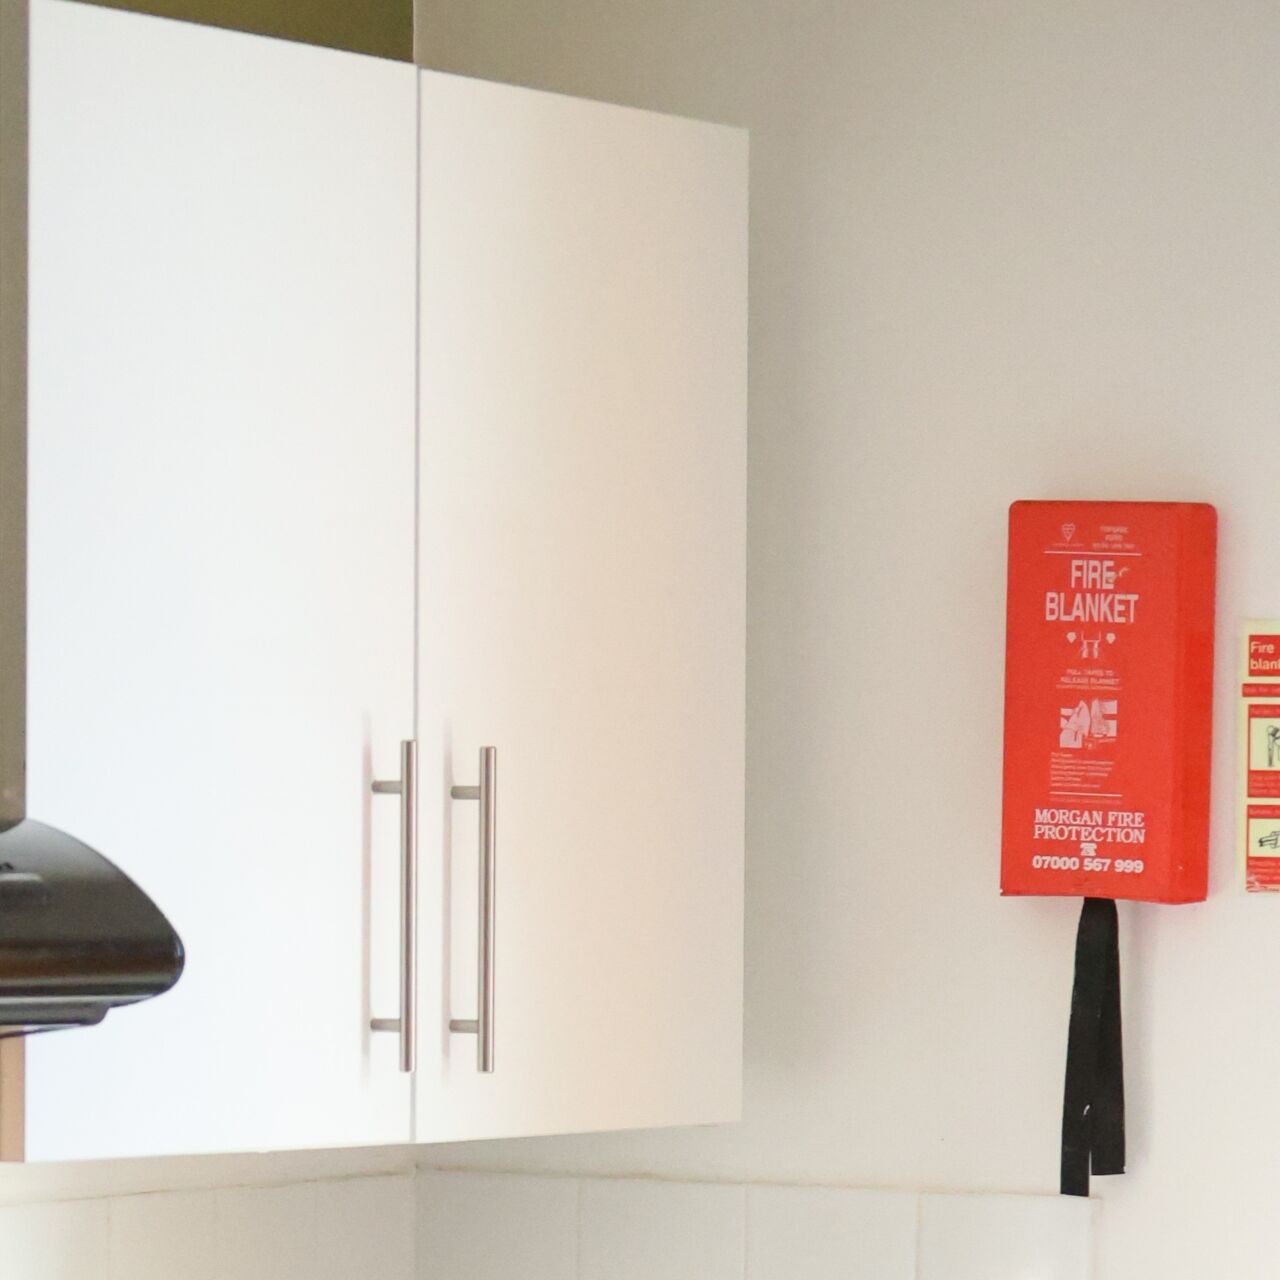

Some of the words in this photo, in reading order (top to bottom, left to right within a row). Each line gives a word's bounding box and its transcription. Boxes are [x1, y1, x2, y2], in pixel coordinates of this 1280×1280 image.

[1071, 559, 1115, 590] FIRE
[1045, 591, 1140, 623] BLANKET
[1250, 641, 1276, 654] Fire
[1034, 808, 1104, 826] MORGAN
[1106, 811, 1145, 828] FIRE
[1033, 824, 1146, 844] PROTECTION
[1032, 855, 1080, 871] 07000
[1083, 858, 1112, 872] 567
[1114, 859, 1145, 874] 999
